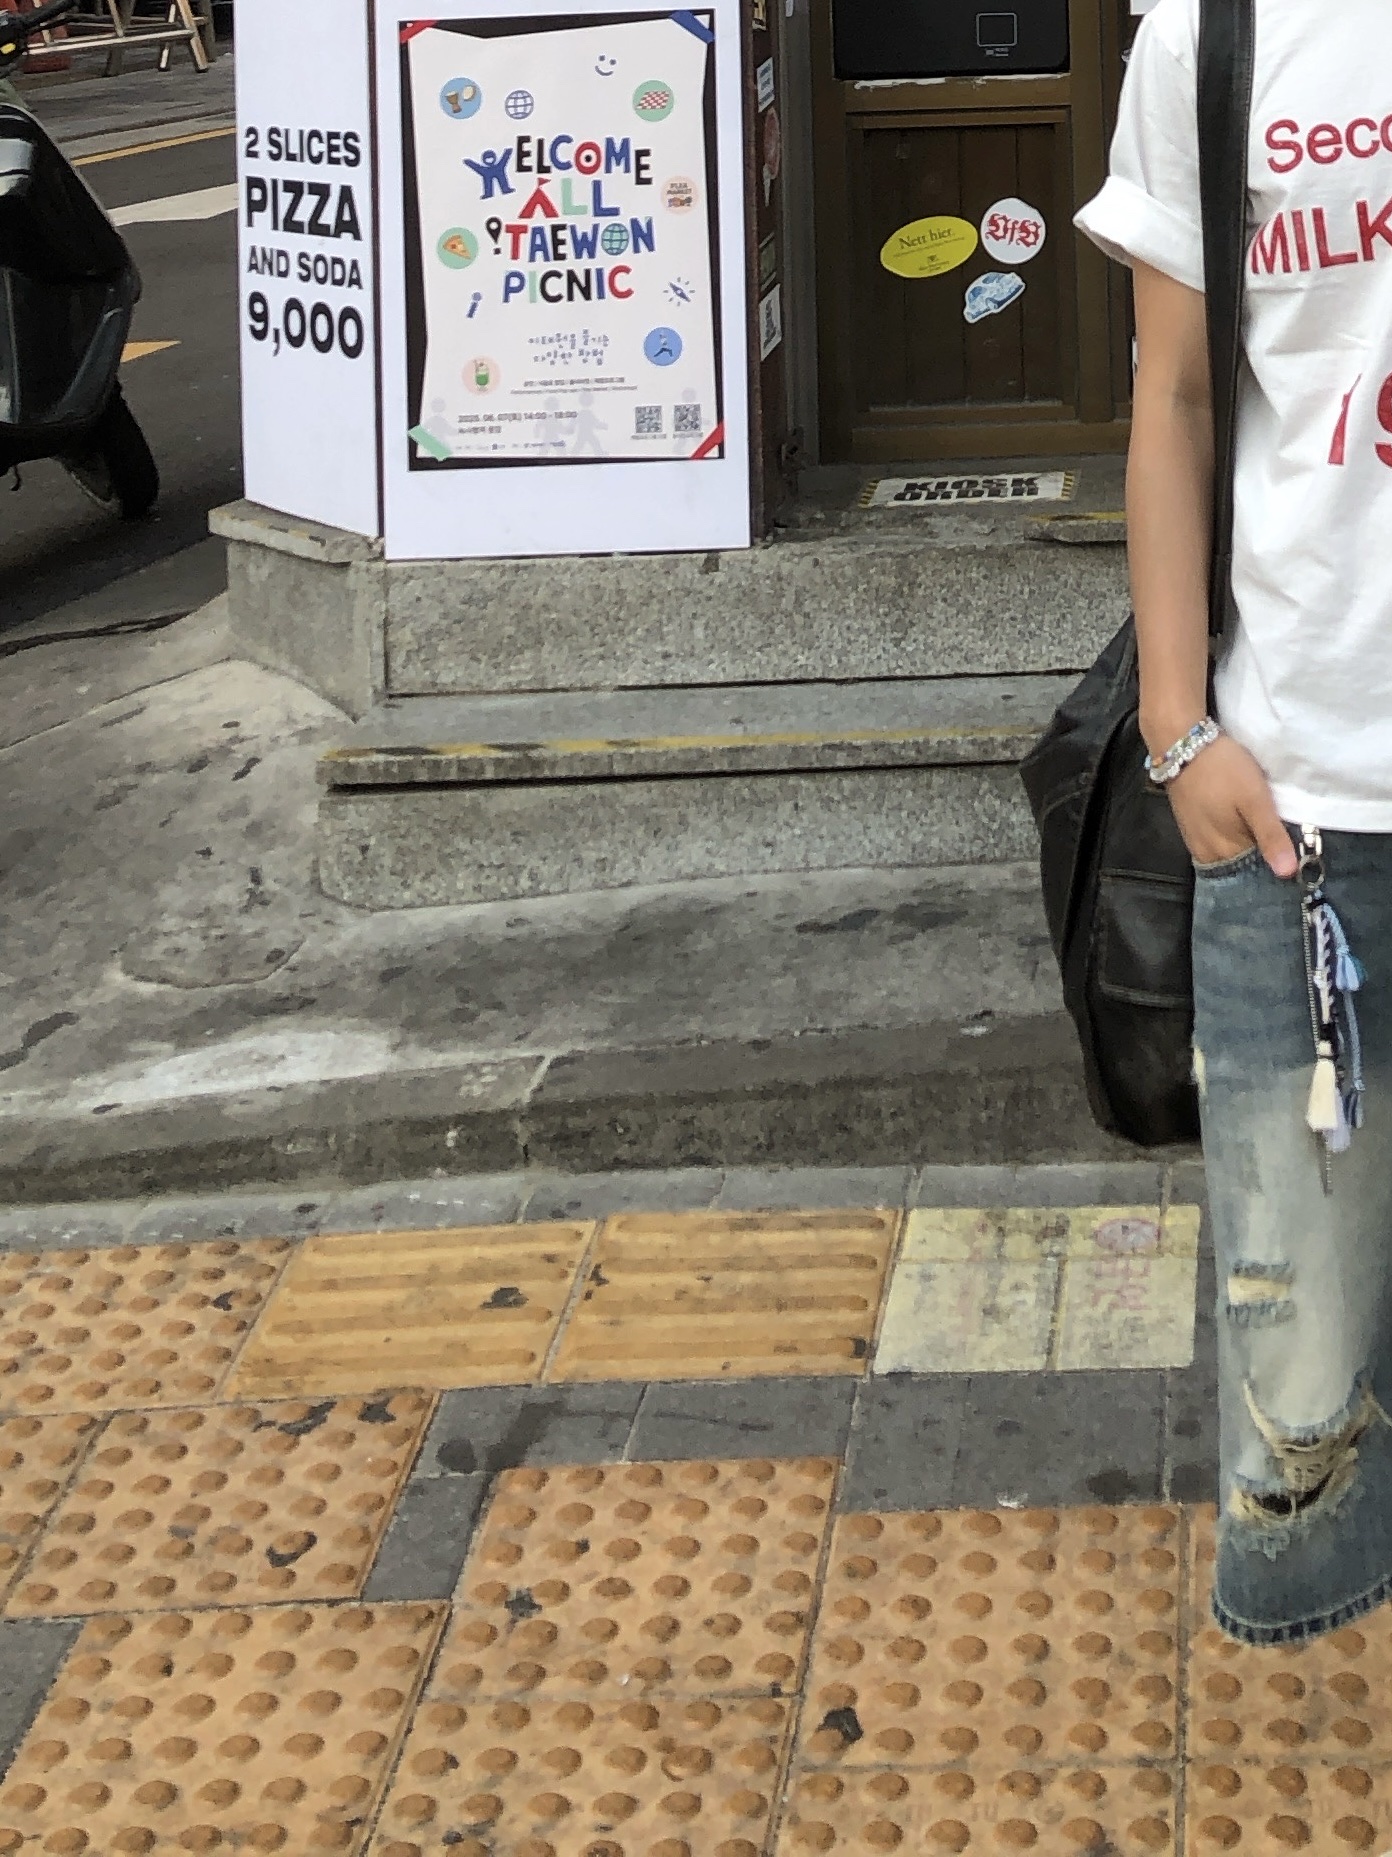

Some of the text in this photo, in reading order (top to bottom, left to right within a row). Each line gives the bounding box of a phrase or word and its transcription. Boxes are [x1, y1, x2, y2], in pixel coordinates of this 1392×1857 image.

[244, 126, 362, 168] 2 SLICES
[463, 134, 653, 200] WELCOME
[246, 176, 363, 242] PIZZA
[519, 178, 621, 219] ALL
[247, 245, 364, 291] AND SODA
[502, 264, 635, 304] PICNIC
[248, 291, 365, 360] 9,000
[903, 477, 1040, 492] KIOSK
